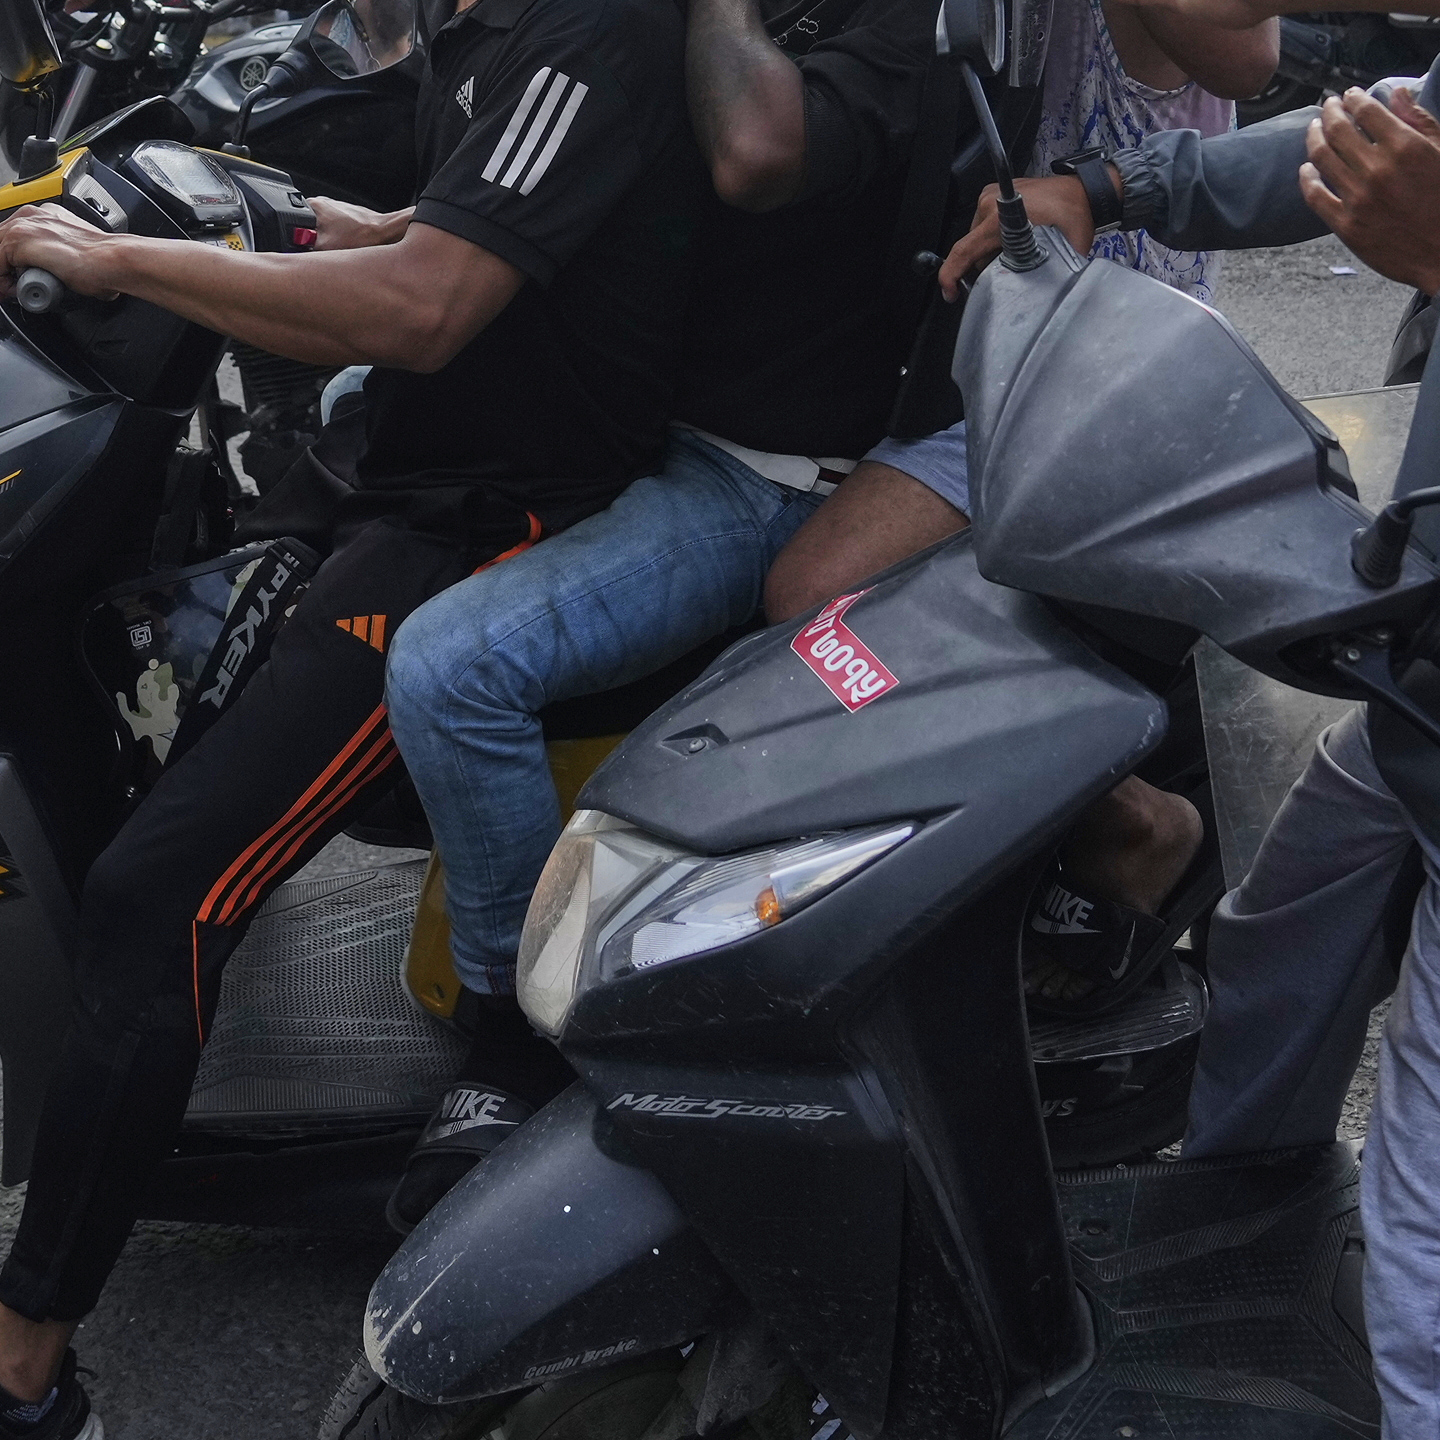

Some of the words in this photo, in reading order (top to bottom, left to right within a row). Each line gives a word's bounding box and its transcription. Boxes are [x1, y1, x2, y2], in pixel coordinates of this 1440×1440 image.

[455, 89, 473, 119] adidas
[441, 1088, 507, 1121] NIKE
[580, 1339, 637, 1365] Brake
